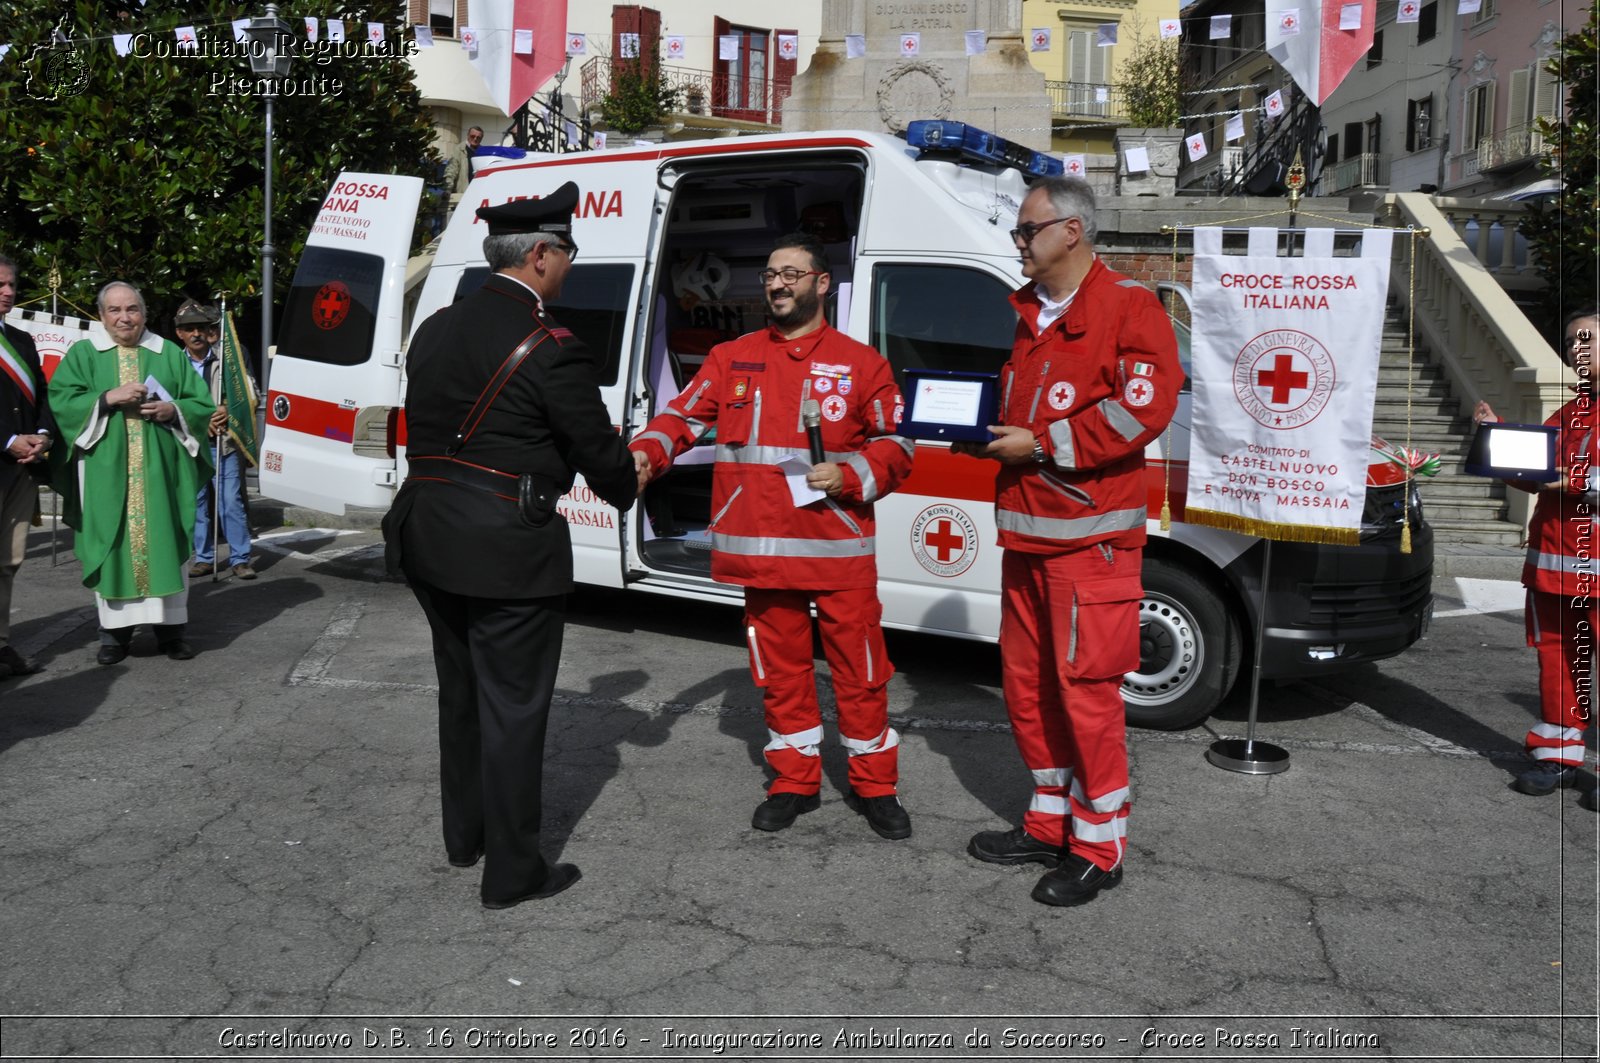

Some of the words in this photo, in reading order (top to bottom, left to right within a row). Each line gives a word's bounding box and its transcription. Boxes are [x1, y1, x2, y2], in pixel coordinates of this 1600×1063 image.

[930, 3, 968, 14] BOSCO
[890, 18, 905, 30] LA
[912, 18, 953, 29] PATRIA
[333, 182, 389, 200] ROSSA
[333, 226, 367, 240] MASSAIA
[1220, 273, 1283, 289] CROCE
[1293, 275, 1357, 290] ROSSA
[1244, 294, 1329, 310] ITALIANA
[31, 333, 65, 344] ROSSA
[1263, 332, 1316, 356] GINEVRA
[1249, 342, 1264, 356] DI
[1313, 353, 1328, 368] 22
[1236, 353, 1273, 424] CONVENZIONE
[1308, 369, 1331, 412] AGOSTO
[1286, 407, 1310, 425] 1864
[1248, 444, 1295, 458] COMITATO
[1300, 449, 1310, 458] DI
[1221, 454, 1338, 476] CASTELNUOVO
[1228, 472, 1257, 486] DON
[1267, 477, 1325, 492] BOSCO
[1205, 484, 1212, 494] E
[1276, 495, 1350, 510] MASSAIA
[558, 507, 614, 529] MASSAIA
[913, 515, 928, 543] CROCE
[927, 507, 954, 517] ROSSA
[955, 512, 976, 551] ITALIANA
